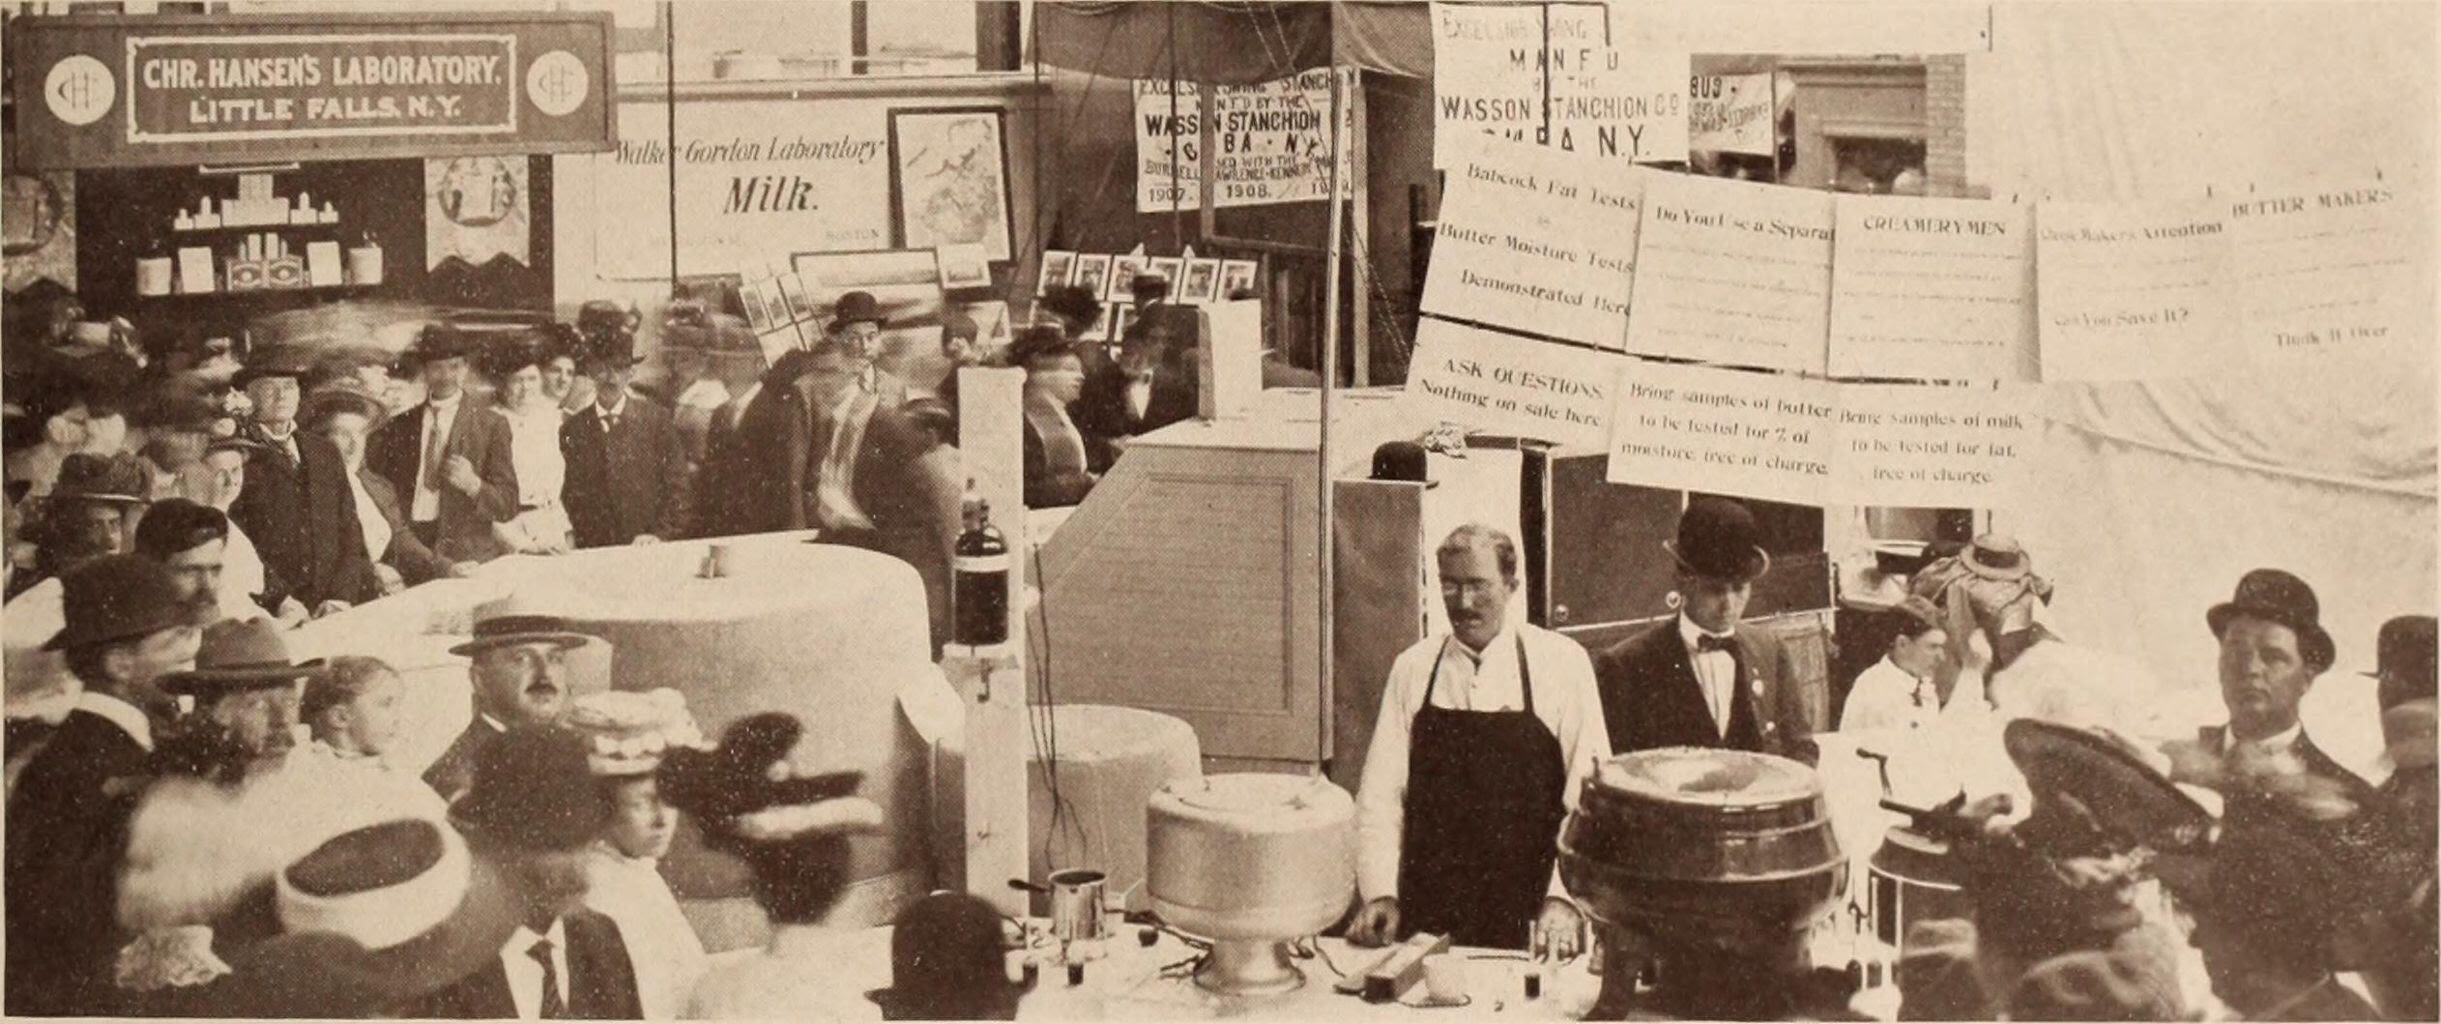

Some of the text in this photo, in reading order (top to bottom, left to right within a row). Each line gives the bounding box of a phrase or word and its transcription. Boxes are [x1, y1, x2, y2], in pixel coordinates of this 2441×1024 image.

[143, 58, 204, 90] CHR.
[208, 54, 321, 89] HANSEN'S
[189, 97, 294, 124] LITTLE
[407, 95, 462, 118] N.Y.
[1145, 110, 1320, 136] WASSN STANCHION
[1441, 97, 1530, 121] WASSON
[685, 138, 761, 163] Gordon
[767, 135, 885, 165] Laboratory
[723, 176, 818, 214] Milk.
[1467, 163, 1537, 191] Babcock
[1591, 187, 1636, 210] Tests
[1657, 206, 1677, 222] Do
[1684, 209, 1714, 226] You
[1753, 222, 1764, 233] a
[2232, 197, 2305, 218] BUTTER
[2143, 222, 2223, 239] Attention
[1440, 223, 1496, 246] Butter
[1506, 235, 1577, 263] Moisture
[1588, 250, 1633, 274] Tests
[1461, 269, 1583, 306] Demonstrated
[1442, 359, 1483, 379] ASK
[1421, 379, 1490, 408] Nothing
[1496, 399, 1516, 411] on
[1525, 403, 1559, 420] sale
[1630, 383, 1833, 418] Bring samples of butter
[1639, 415, 1810, 445] to be tested for % of
[1891, 411, 1956, 429] samples
[1963, 411, 1980, 427] of
[1986, 413, 2023, 430] milk
[1704, 450, 1736, 466] free
[1741, 455, 1757, 467] of
[1852, 439, 1868, 452] to
[1873, 438, 1892, 452] be
[1899, 440, 1949, 454] tested
[1956, 442, 1980, 456] for
[1873, 465, 1904, 480] free
[1910, 466, 1925, 480] of
